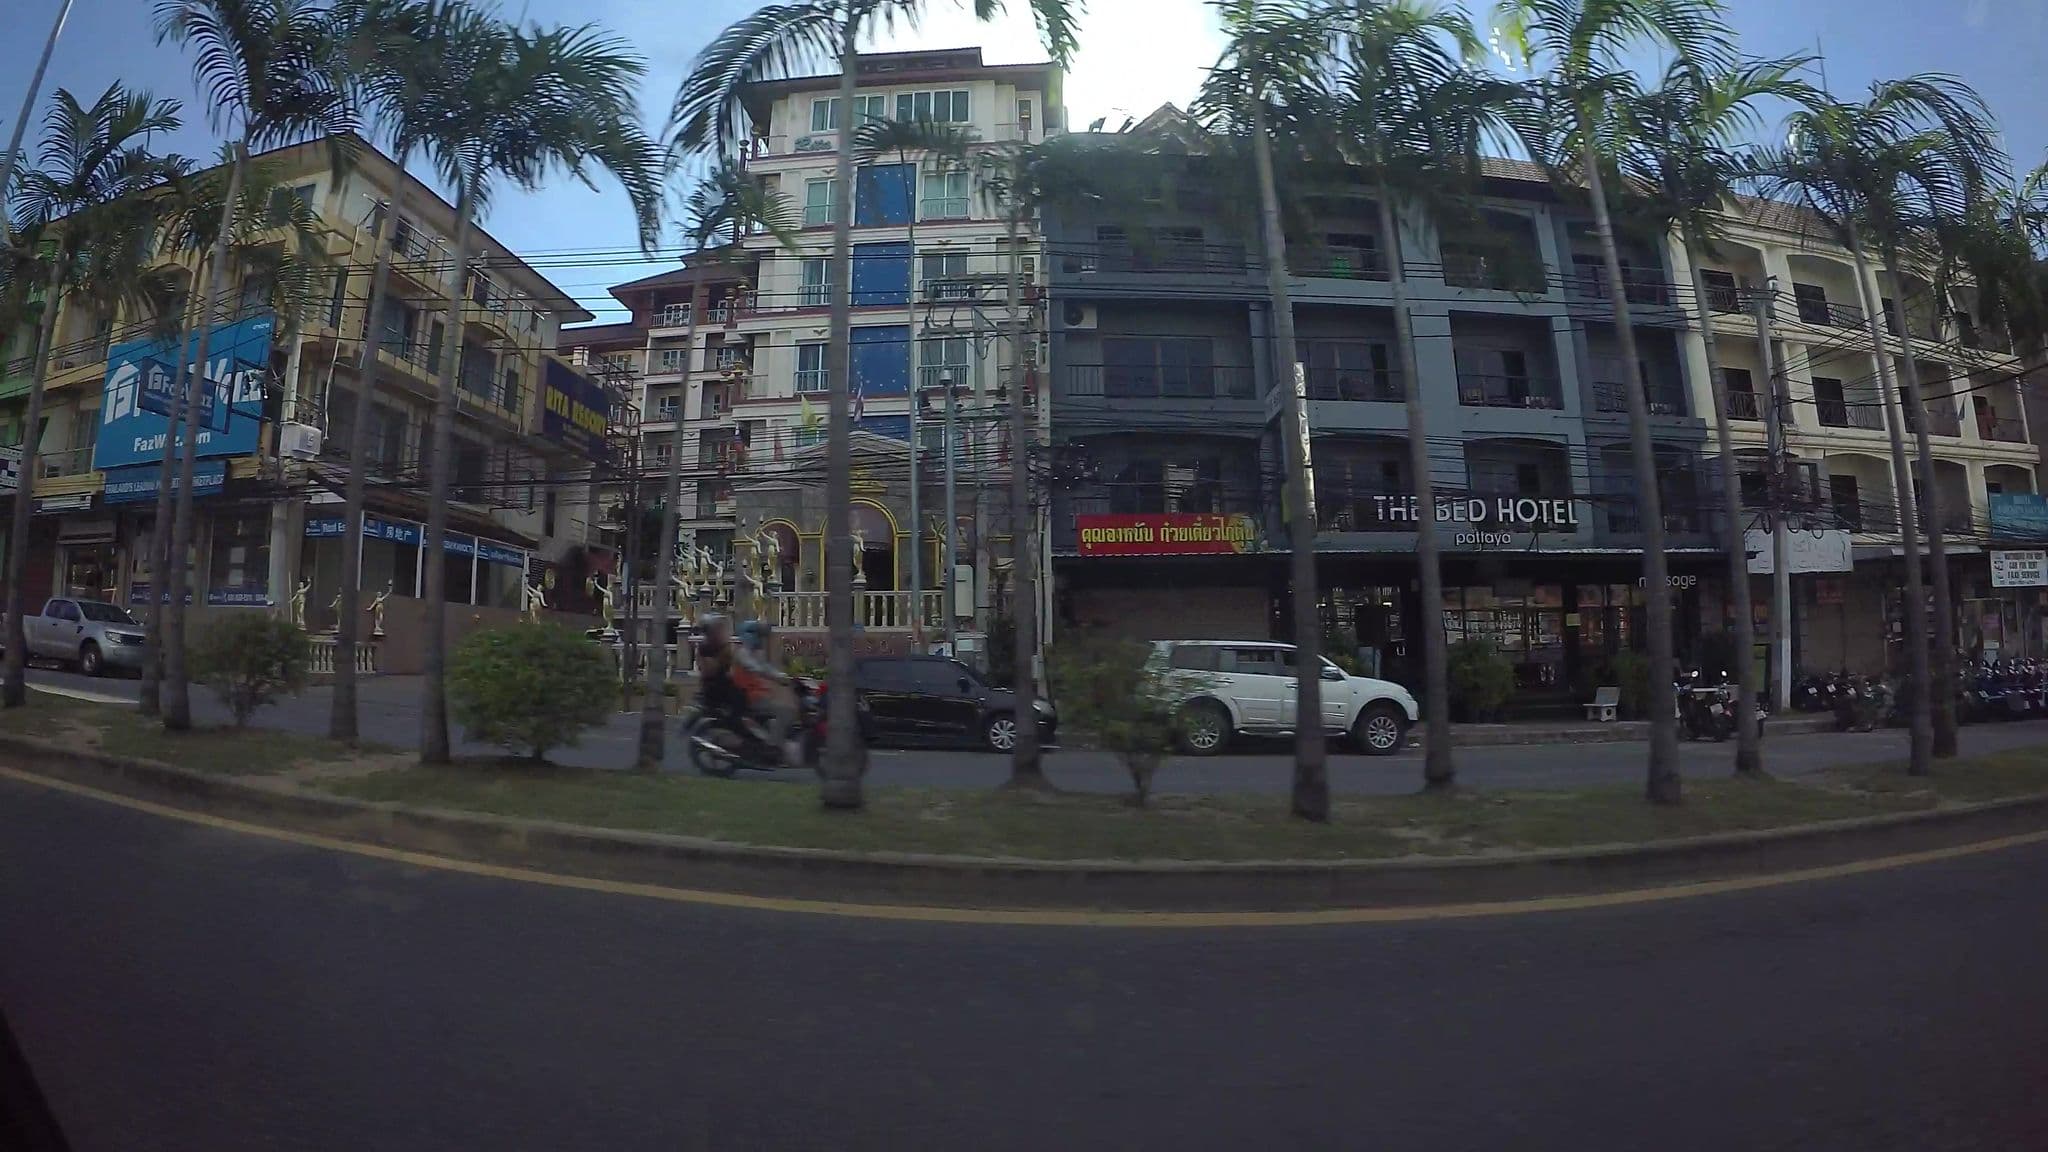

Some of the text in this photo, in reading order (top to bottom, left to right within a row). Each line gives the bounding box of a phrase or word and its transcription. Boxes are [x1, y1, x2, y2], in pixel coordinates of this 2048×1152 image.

[1373, 495, 1579, 524] THE BED HOTEL
[1455, 531, 1512, 546] pattaya
[1638, 574, 1697, 590] msage
